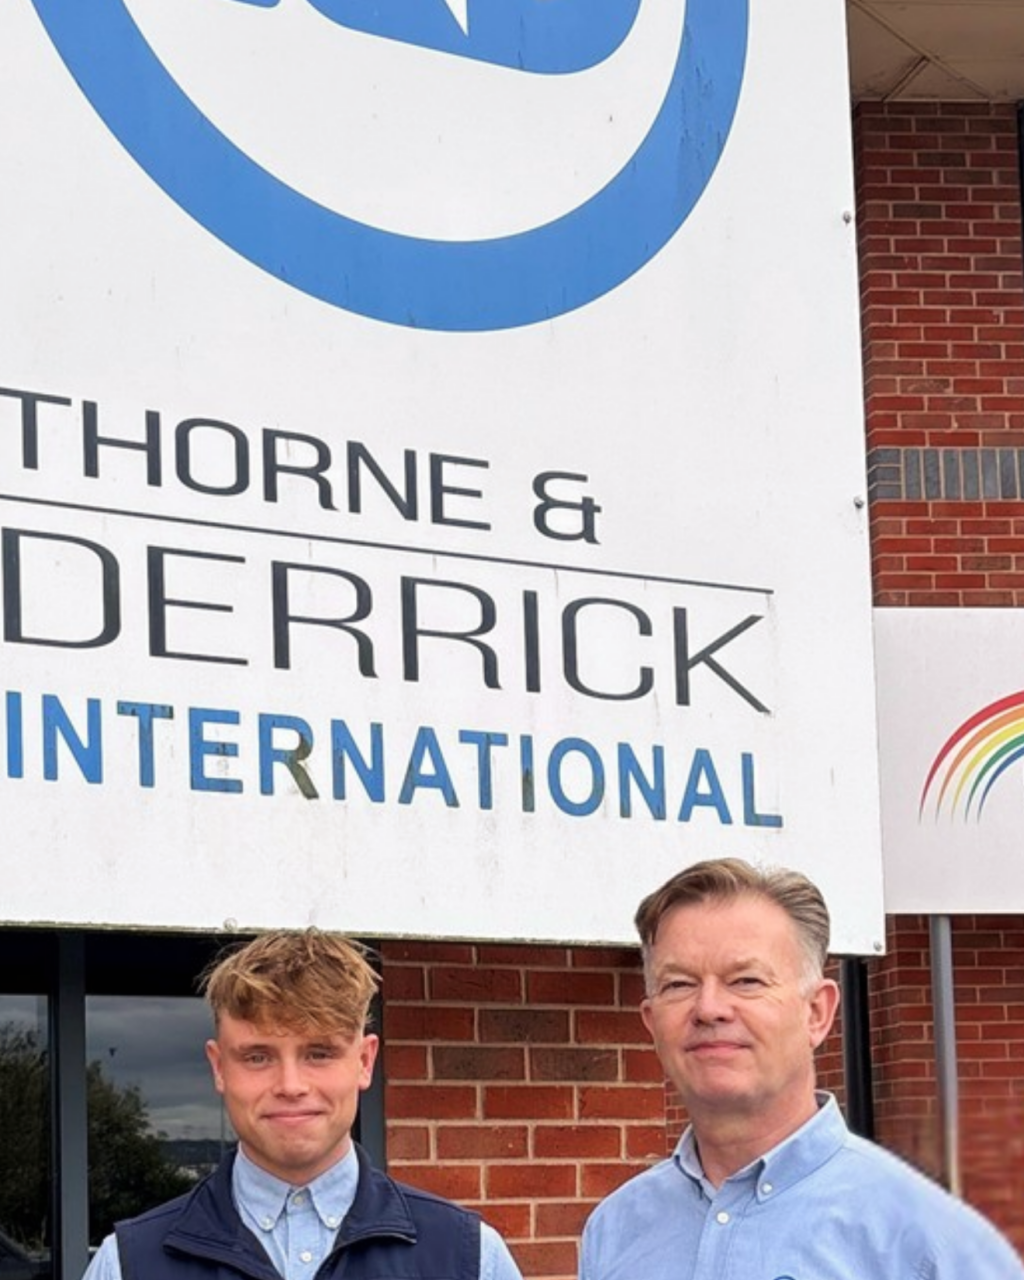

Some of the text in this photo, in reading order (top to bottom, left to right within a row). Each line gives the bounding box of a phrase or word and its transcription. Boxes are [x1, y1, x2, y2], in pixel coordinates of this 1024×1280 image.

[531, 471, 603, 546] &
[0, 526, 772, 714] DERRICK
[4, 689, 784, 829] INTERNATIONAL
